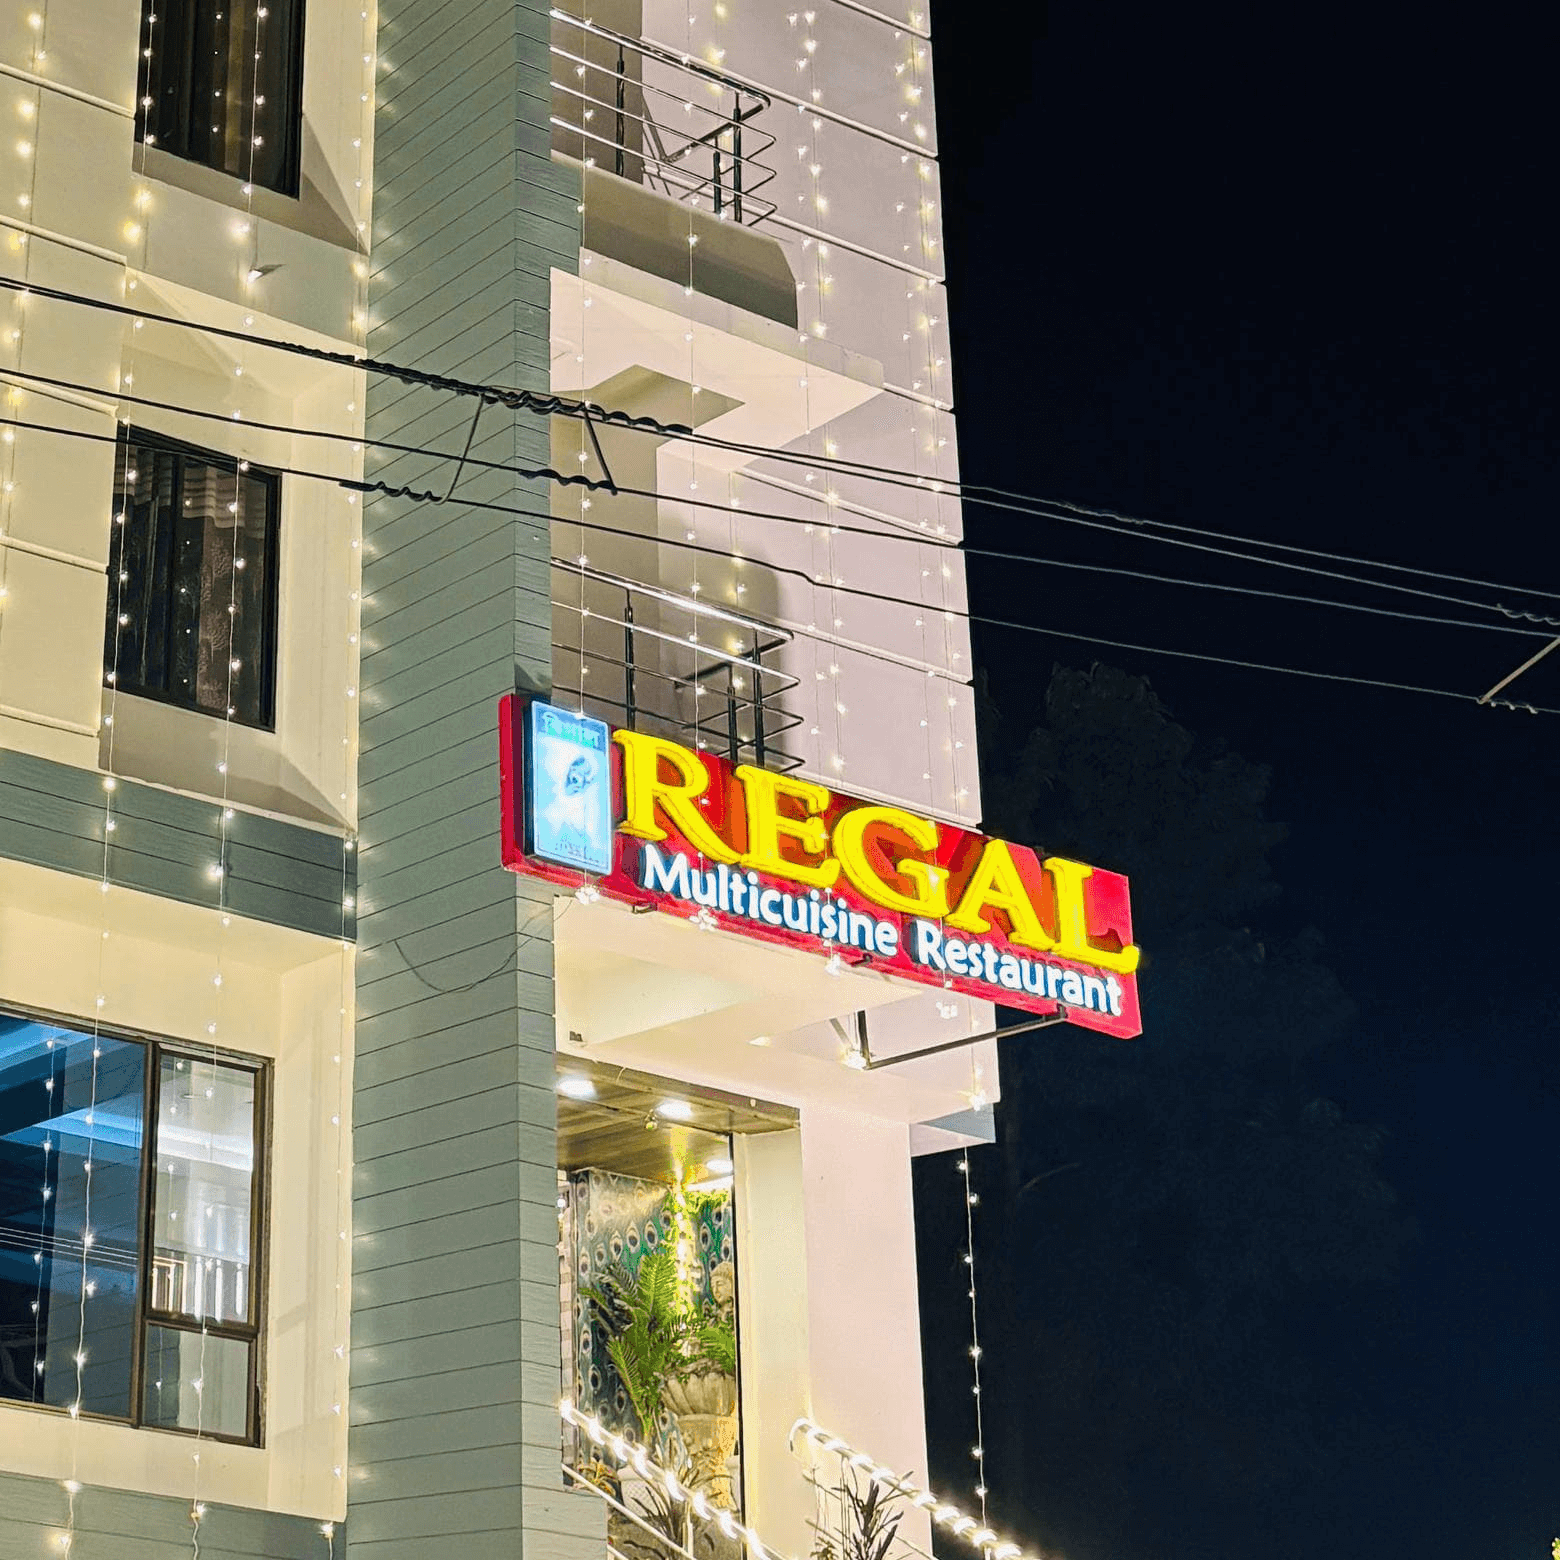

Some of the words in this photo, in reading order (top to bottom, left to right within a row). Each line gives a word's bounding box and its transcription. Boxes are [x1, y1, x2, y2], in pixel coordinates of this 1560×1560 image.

[613, 728, 1140, 973] REGAL
[643, 844, 898, 957] Multicuisine
[917, 919, 1122, 1017] Restaurant
